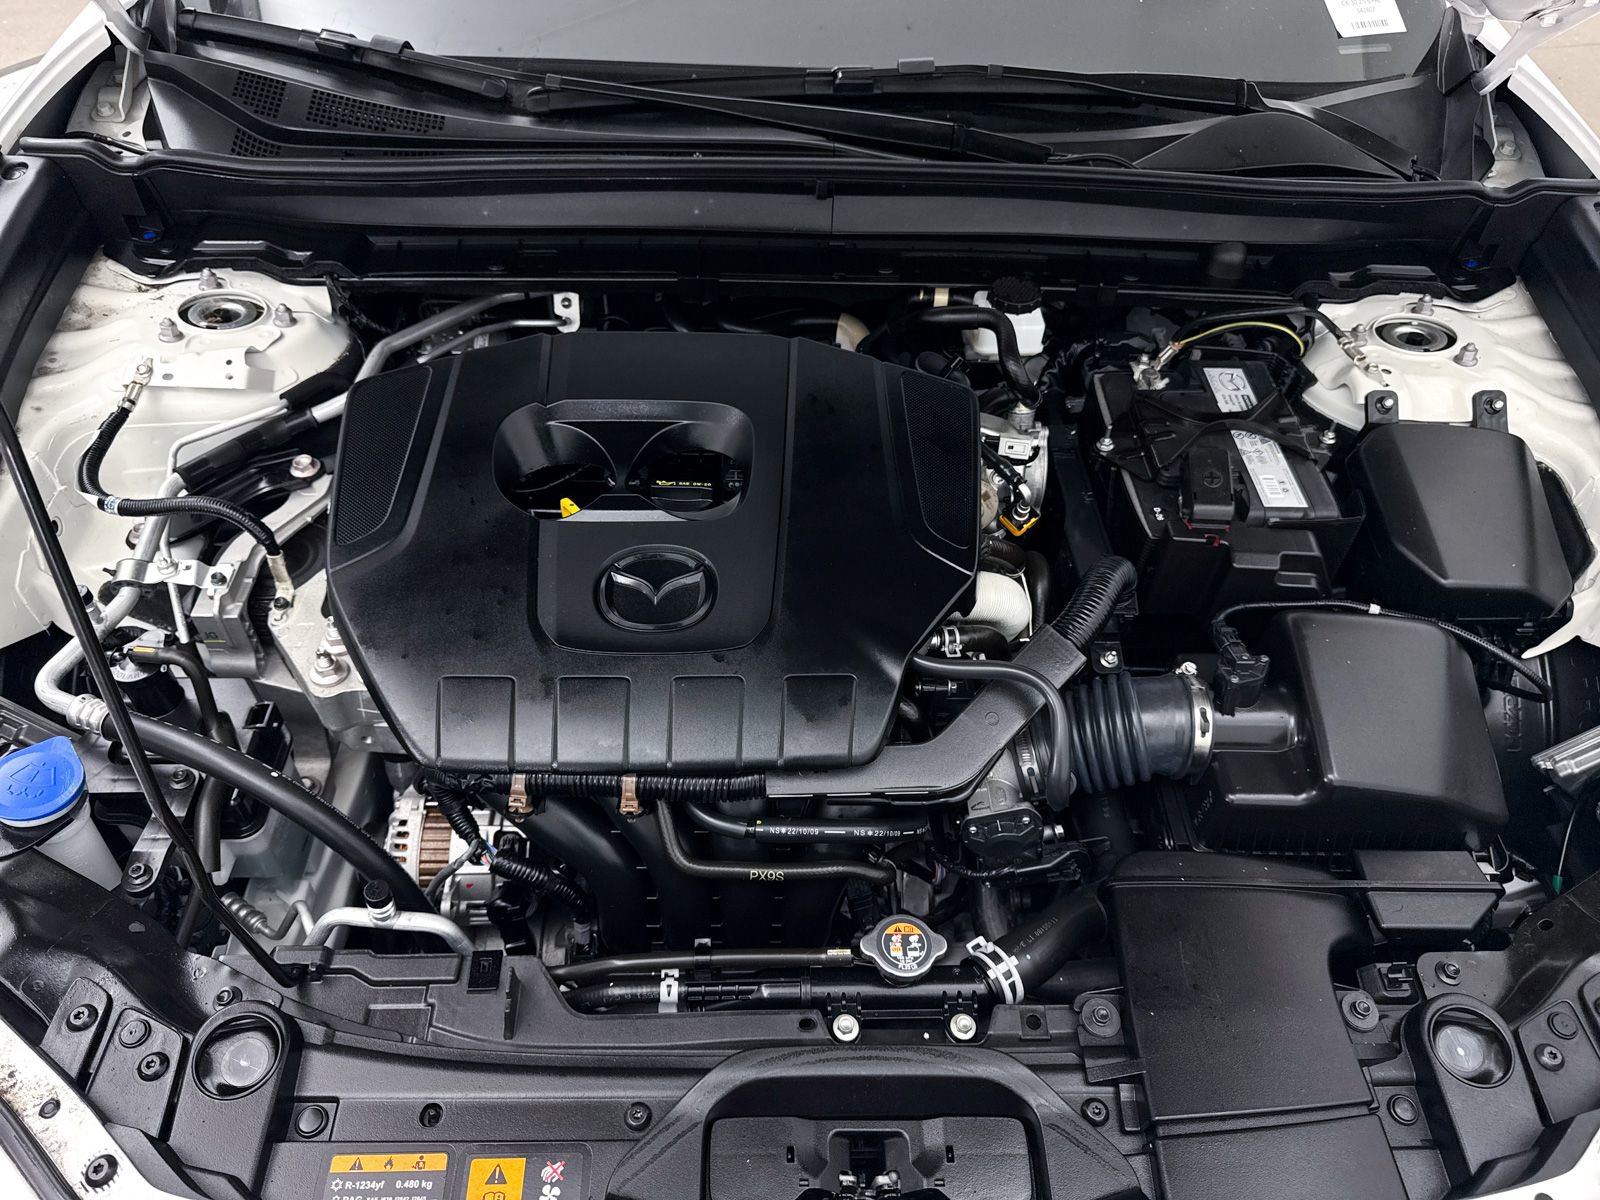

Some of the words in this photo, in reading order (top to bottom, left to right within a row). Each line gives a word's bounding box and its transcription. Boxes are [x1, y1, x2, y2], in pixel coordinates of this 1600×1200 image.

[345, 1181, 385, 1190] R-1234yf
[396, 1180, 420, 1189] 0.480
[421, 1180, 433, 1190] kg
